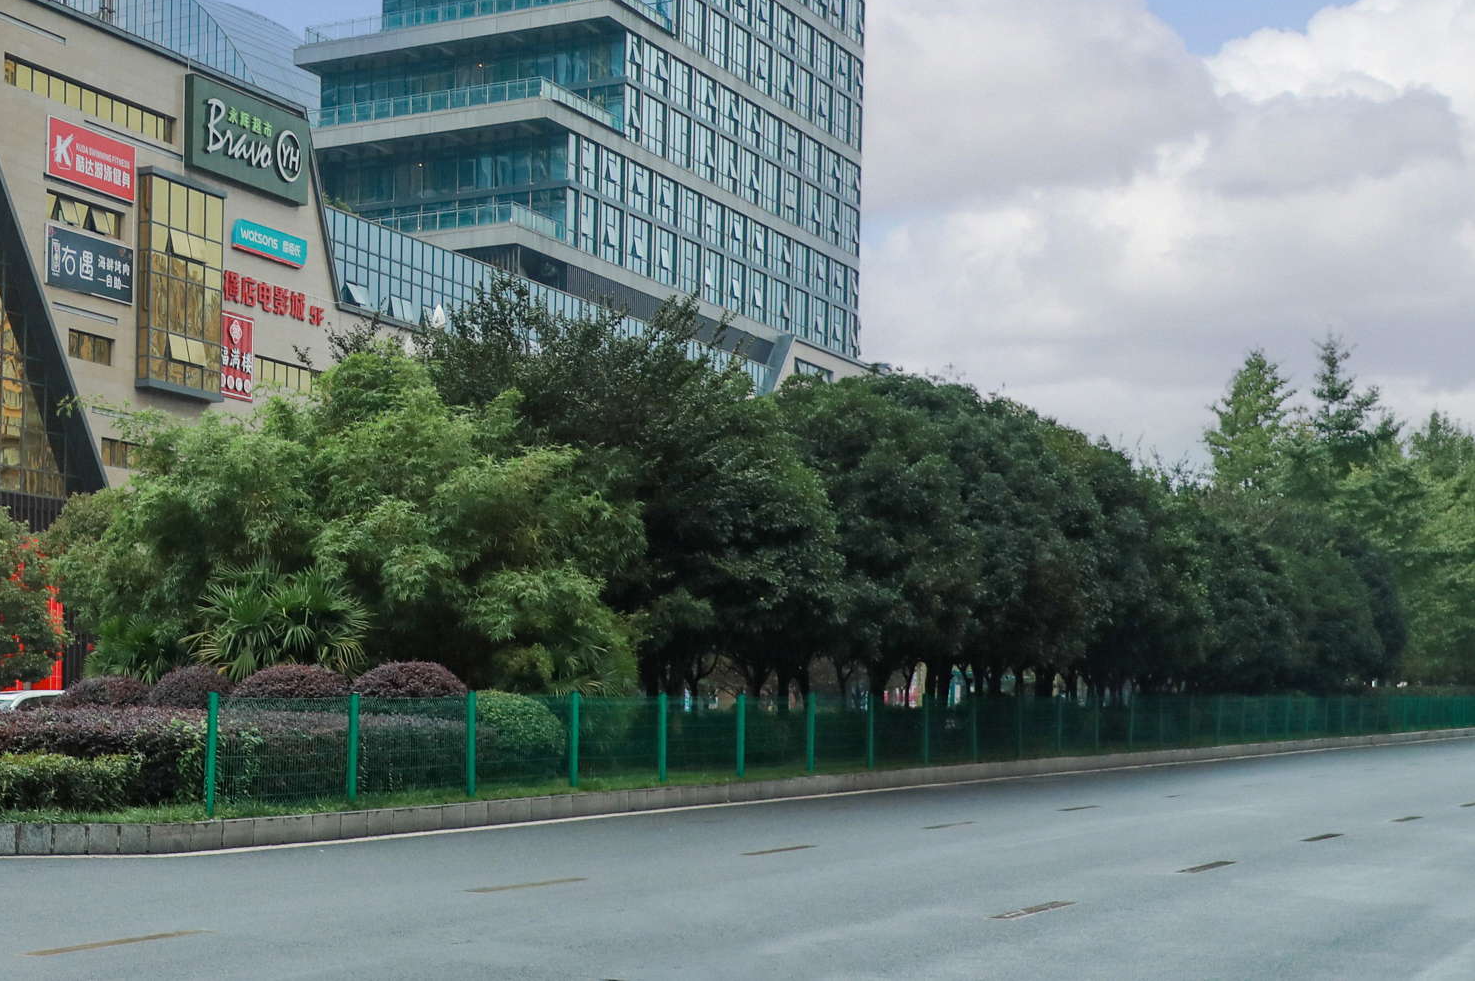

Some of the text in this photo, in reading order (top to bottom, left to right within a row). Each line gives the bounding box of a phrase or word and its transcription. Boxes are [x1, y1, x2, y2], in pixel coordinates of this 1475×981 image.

[206, 98, 273, 168] Bravo
[227, 106, 273, 137] 永辉超市
[75, 154, 131, 189] 酷达游泳健身
[112, 155, 131, 169] FITNESS
[281, 143, 300, 172] YH
[240, 227, 302, 258] watsons 屈臣氏
[97, 254, 130, 276] 海鲜烤肉
[223, 269, 326, 326] 横店电影城 5F
